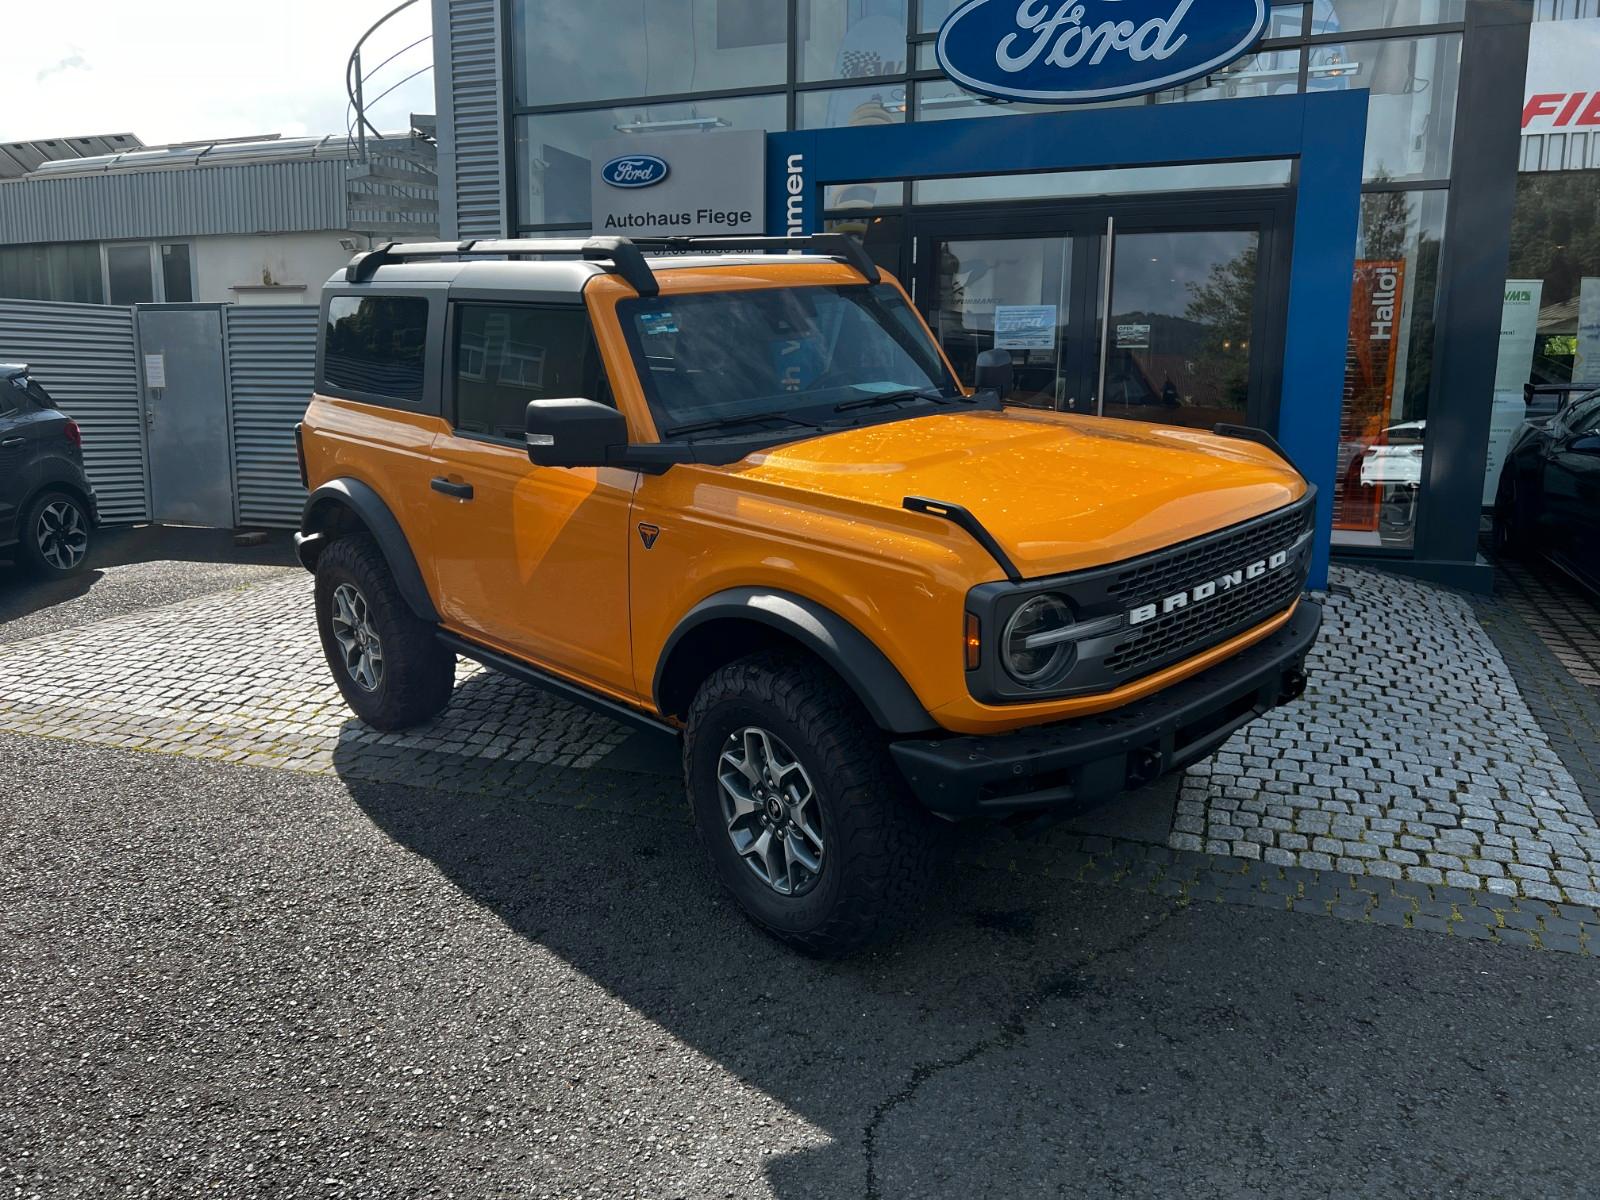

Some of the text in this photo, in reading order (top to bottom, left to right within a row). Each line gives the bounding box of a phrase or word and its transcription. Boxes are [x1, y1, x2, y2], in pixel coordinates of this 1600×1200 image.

[995, 0, 1193, 73] Ford
[614, 160, 654, 181] Ford
[604, 208, 752, 228] Autohaus Fiege
[1370, 268, 1397, 340] Hallo!
[1130, 550, 1287, 625] BRONCO
